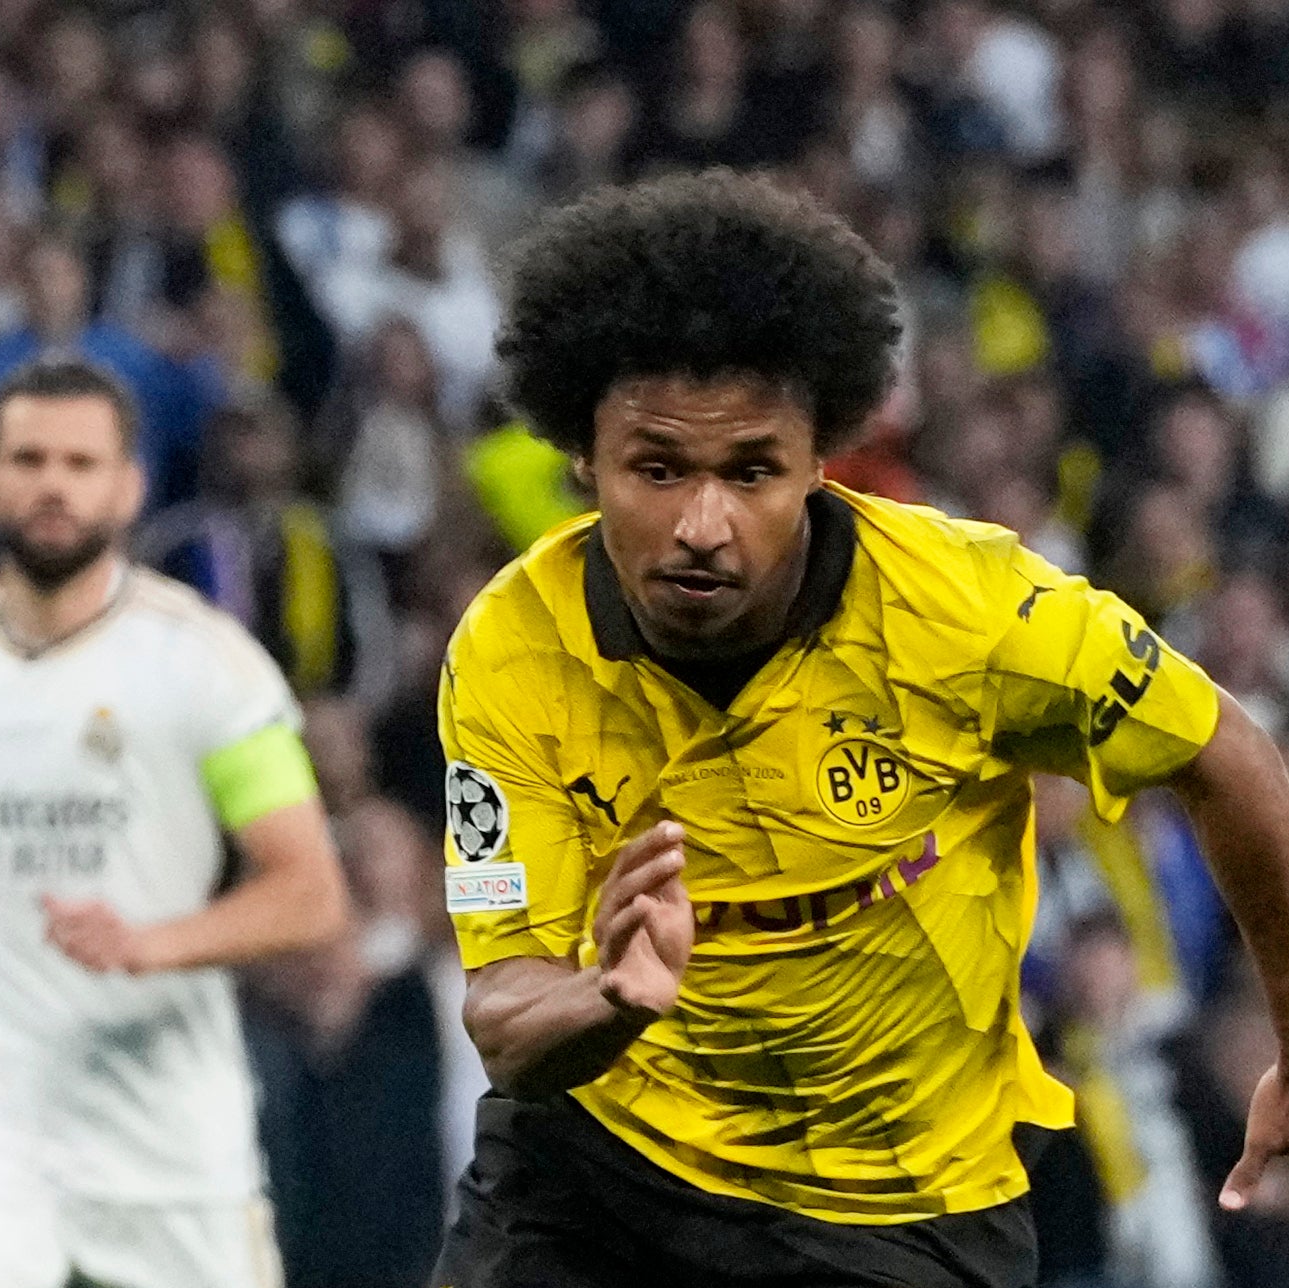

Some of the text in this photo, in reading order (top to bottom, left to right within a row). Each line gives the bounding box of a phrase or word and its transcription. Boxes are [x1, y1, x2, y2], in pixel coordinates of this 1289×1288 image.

[1089, 618, 1161, 748] GLS
[827, 745, 900, 804] BVB
[856, 797, 882, 818] 09
